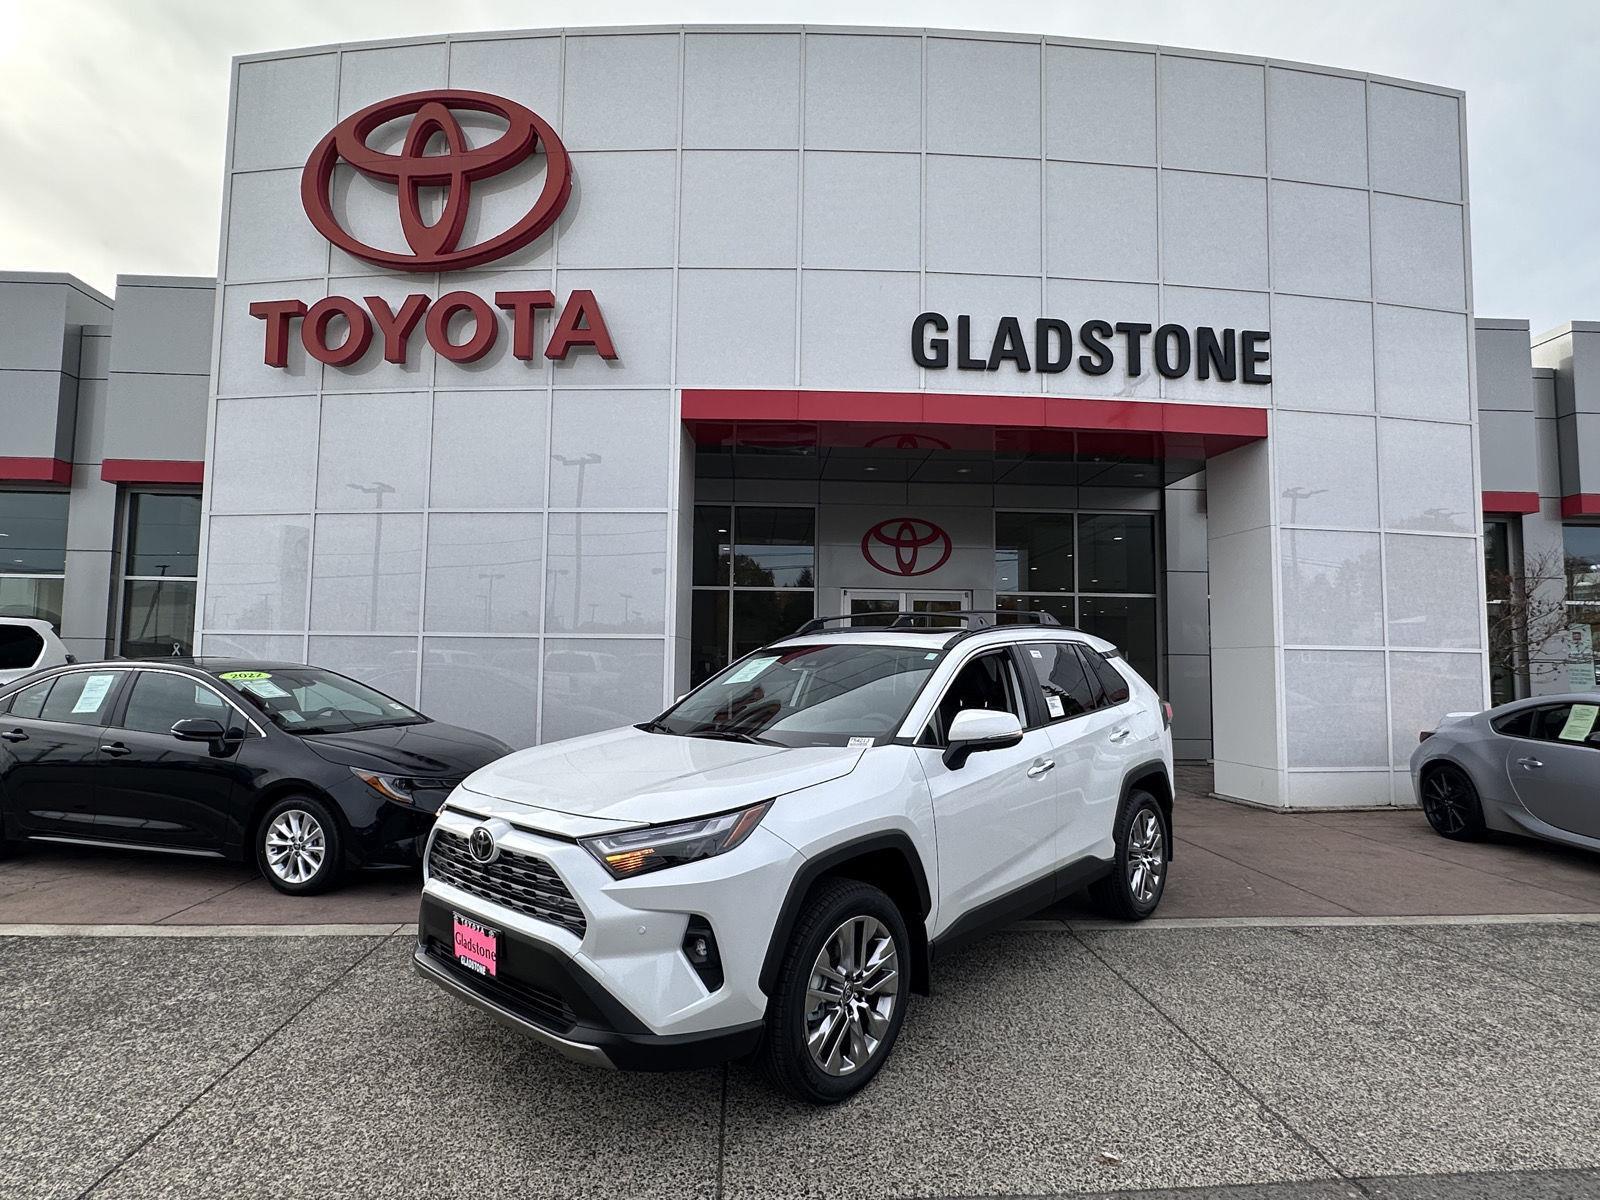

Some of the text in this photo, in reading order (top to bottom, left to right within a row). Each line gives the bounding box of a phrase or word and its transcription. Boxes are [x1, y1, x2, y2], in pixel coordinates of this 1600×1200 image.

[249, 289, 619, 368] TOYOTA
[911, 312, 1272, 384] GLADSTONE
[455, 931, 497, 961] Gladstone
[460, 955, 487, 976] GLADSTONE
